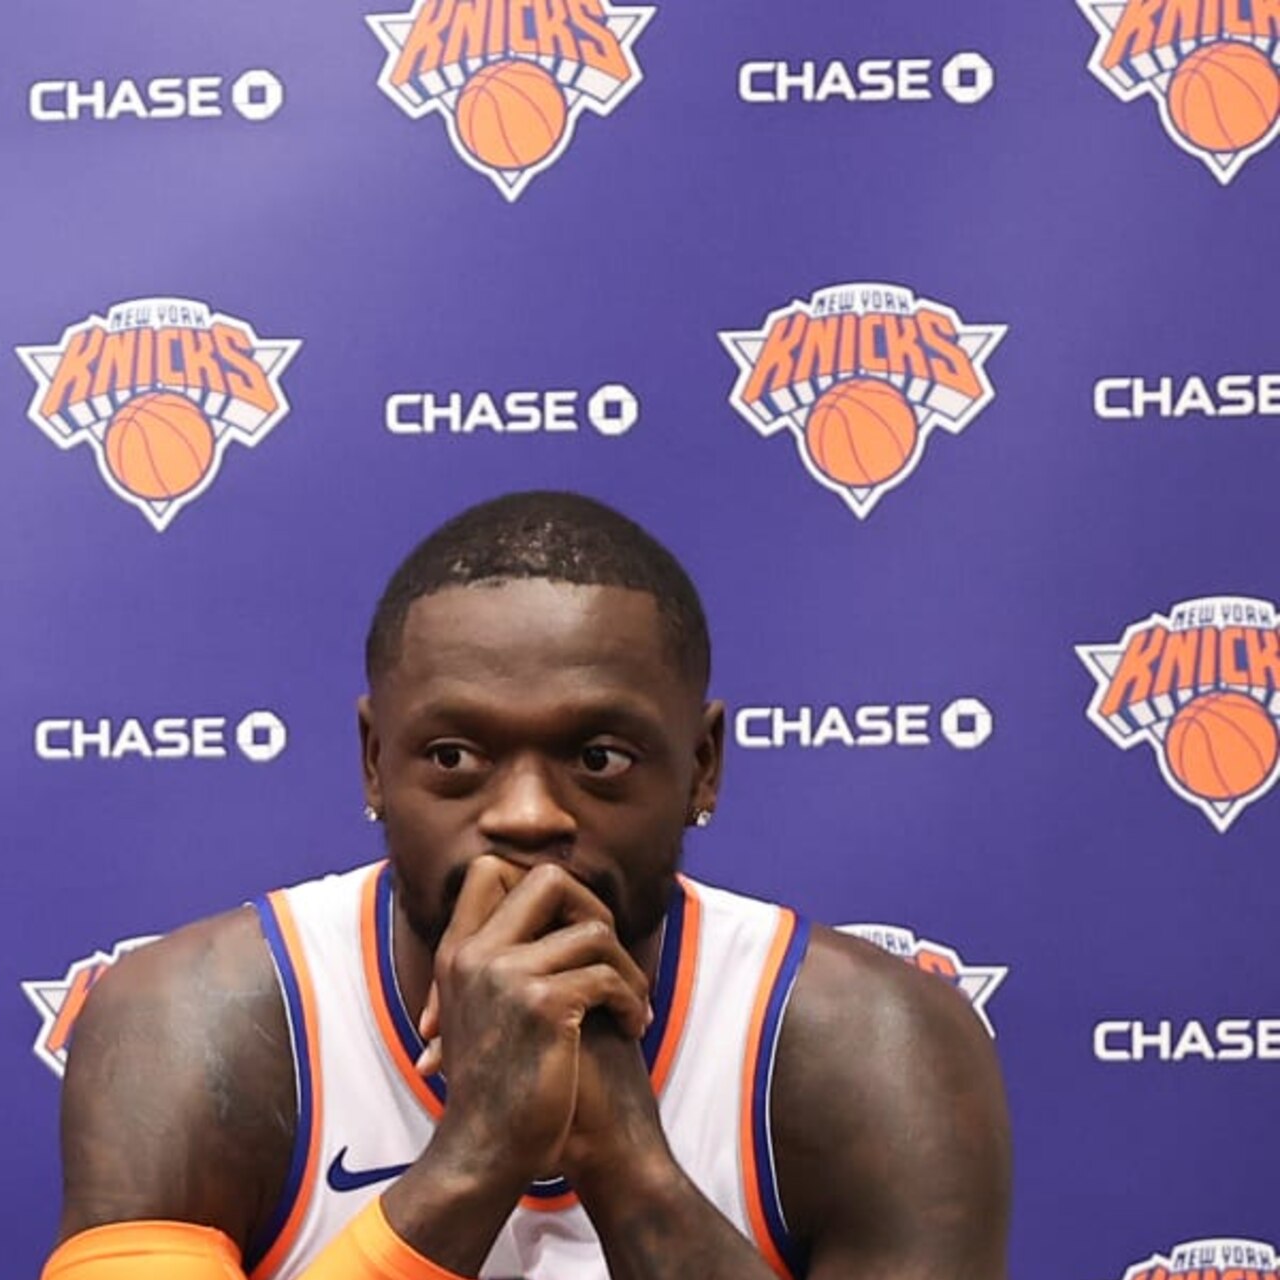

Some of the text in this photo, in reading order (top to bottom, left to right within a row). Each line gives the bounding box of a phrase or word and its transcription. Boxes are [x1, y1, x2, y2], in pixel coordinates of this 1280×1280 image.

[392, 0, 631, 84] KNICKS
[28, 75, 224, 123] CHASE
[738, 58, 932, 103] CHASE
[110, 304, 206, 331] NEW YORK
[813, 289, 910, 315] NEW YORK
[42, 325, 279, 417] KNICKS
[742, 308, 985, 406] KNICKS
[385, 390, 579, 435] CHASE
[1093, 374, 1280, 419] CHASE
[1172, 602, 1273, 630] NEW YORK
[1098, 625, 1280, 718] KNICK
[34, 716, 227, 760] CHASE
[735, 704, 931, 748] CHASE
[1093, 1019, 1280, 1061] CHASE
[1172, 1245, 1273, 1271] NEW YORK
